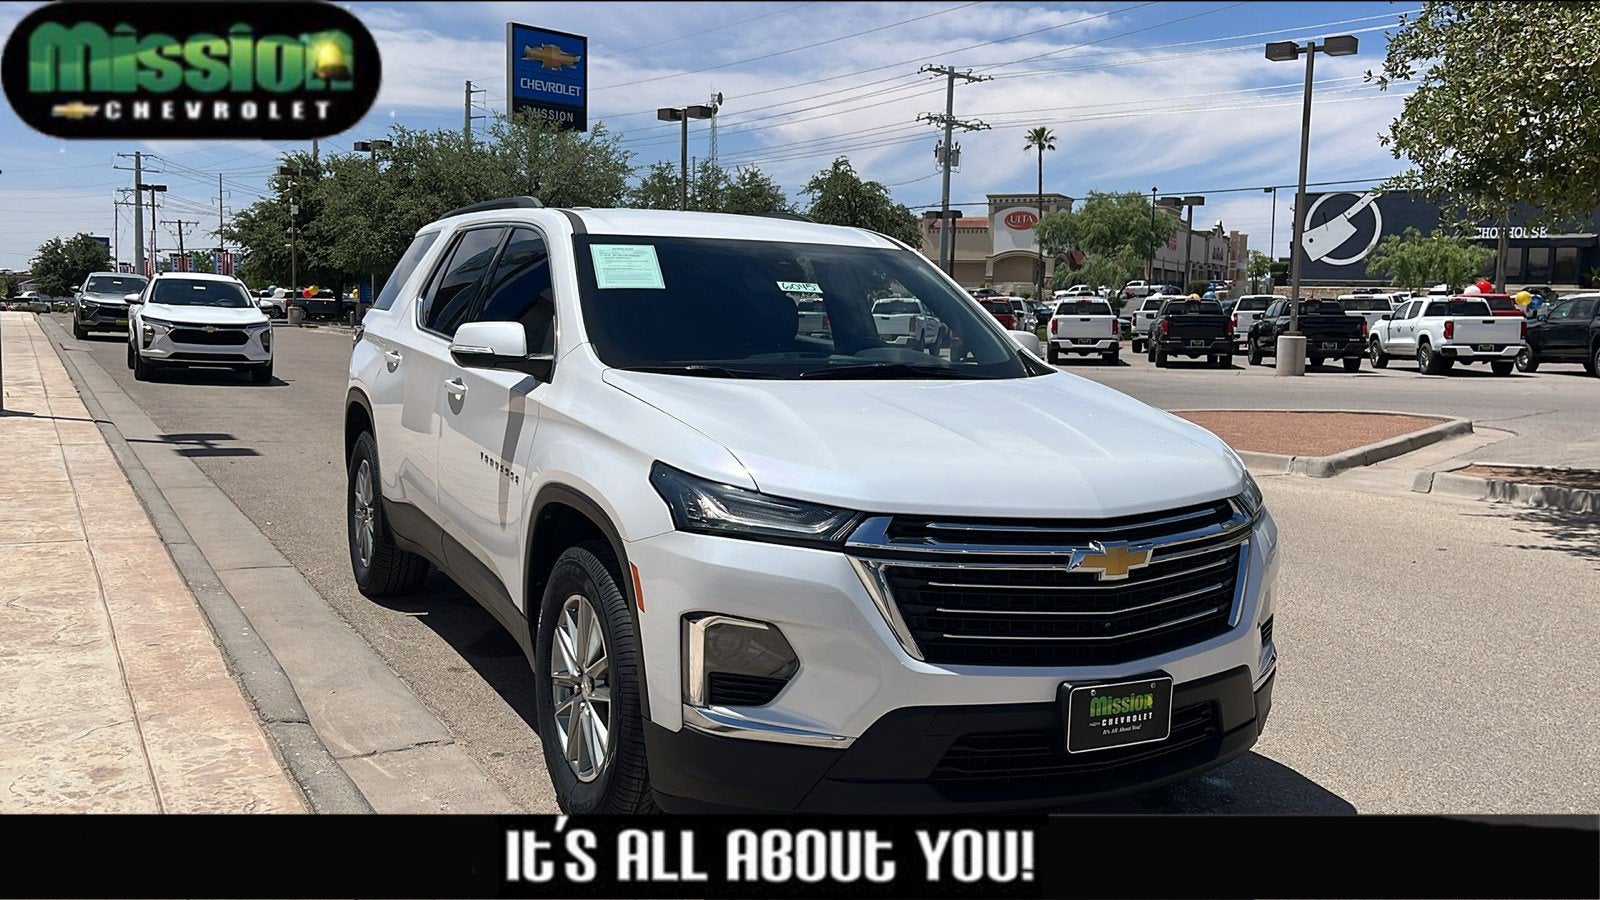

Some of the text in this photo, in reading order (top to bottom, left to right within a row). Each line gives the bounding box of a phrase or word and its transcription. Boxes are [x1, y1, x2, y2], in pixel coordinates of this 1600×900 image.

[520, 77, 582, 97] CHEVROLET
[1010, 214, 1033, 224] ULTA
[1090, 693, 1154, 718] Mission
[1101, 712, 1153, 727] CHEVROLET
